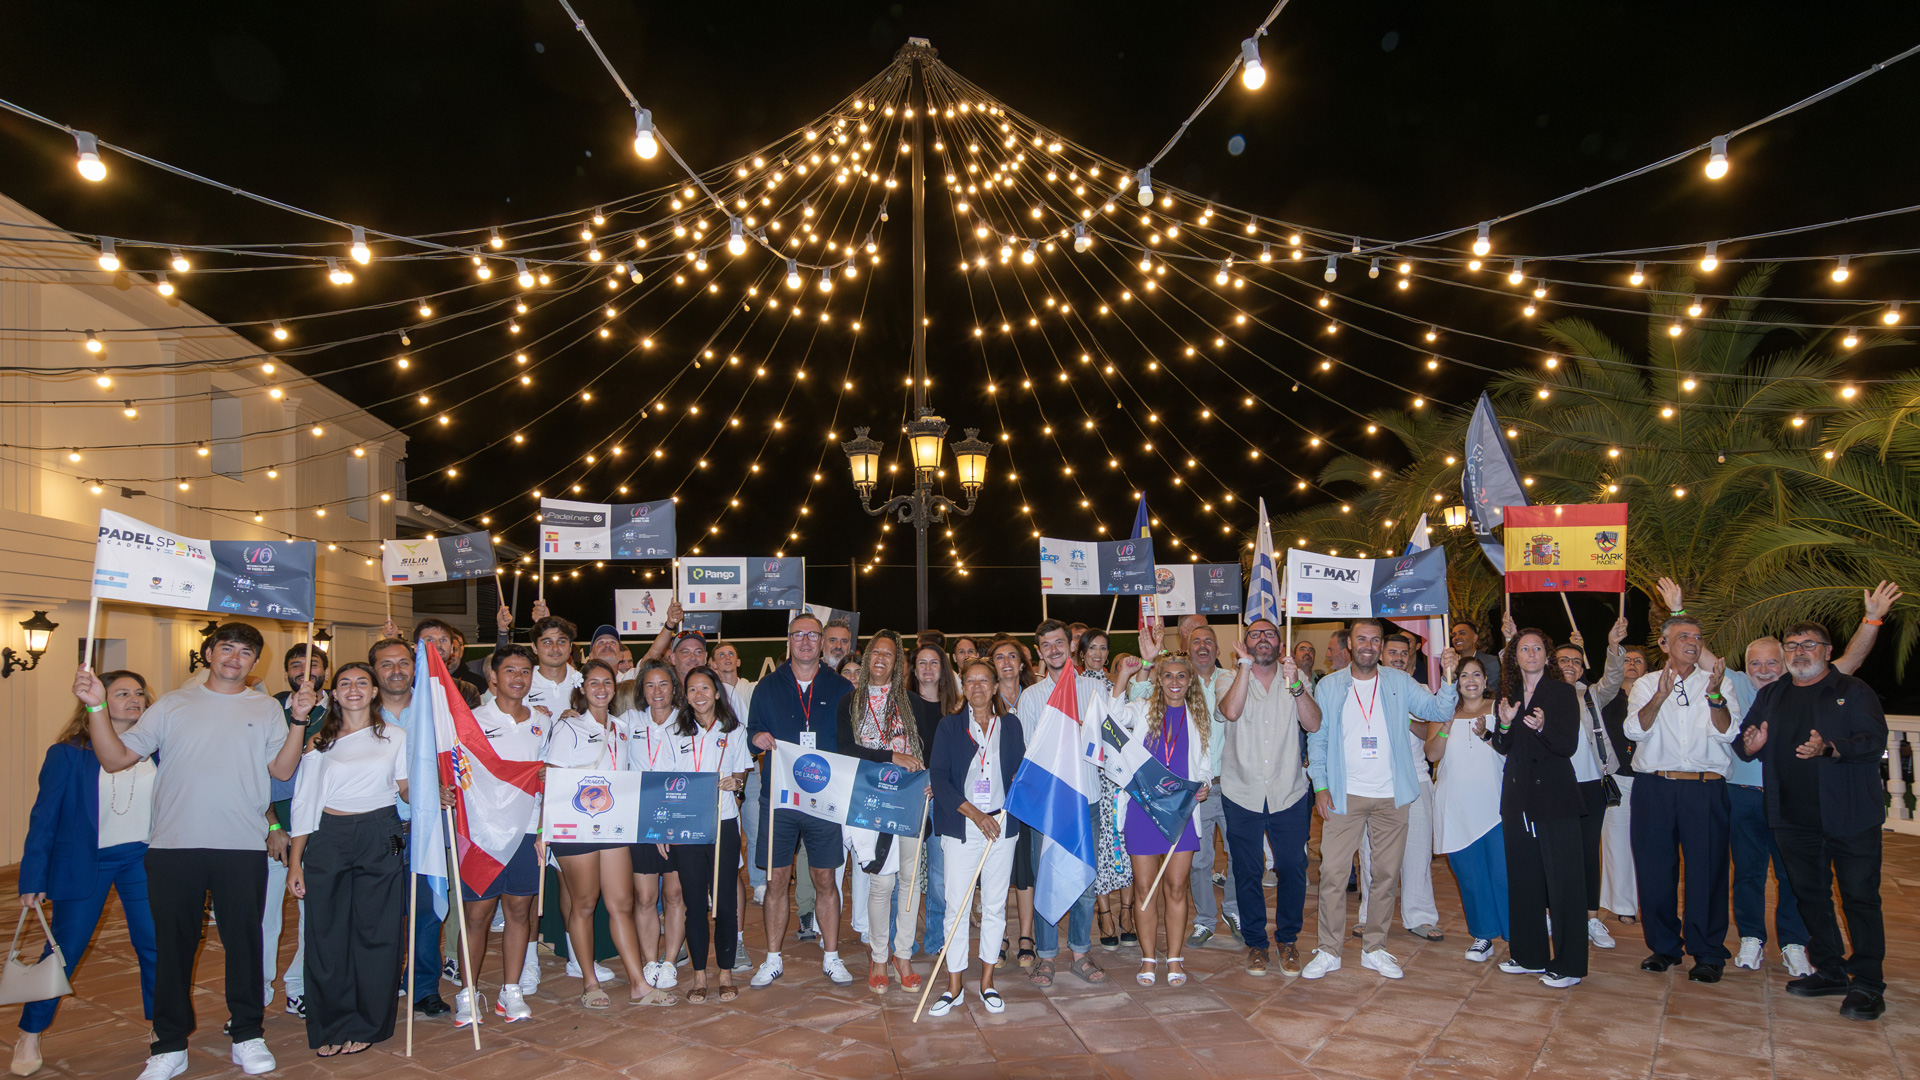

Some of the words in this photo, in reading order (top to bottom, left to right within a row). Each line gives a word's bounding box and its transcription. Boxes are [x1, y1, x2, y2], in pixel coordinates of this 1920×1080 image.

[98, 526, 154, 546] PADEL
[98, 538, 160, 552] ACADEMY
[400, 556, 429, 565] SILIN
[1590, 552, 1624, 561] SHARK
[705, 570, 735, 580] Pango
[803, 766, 819, 775] CLUB
